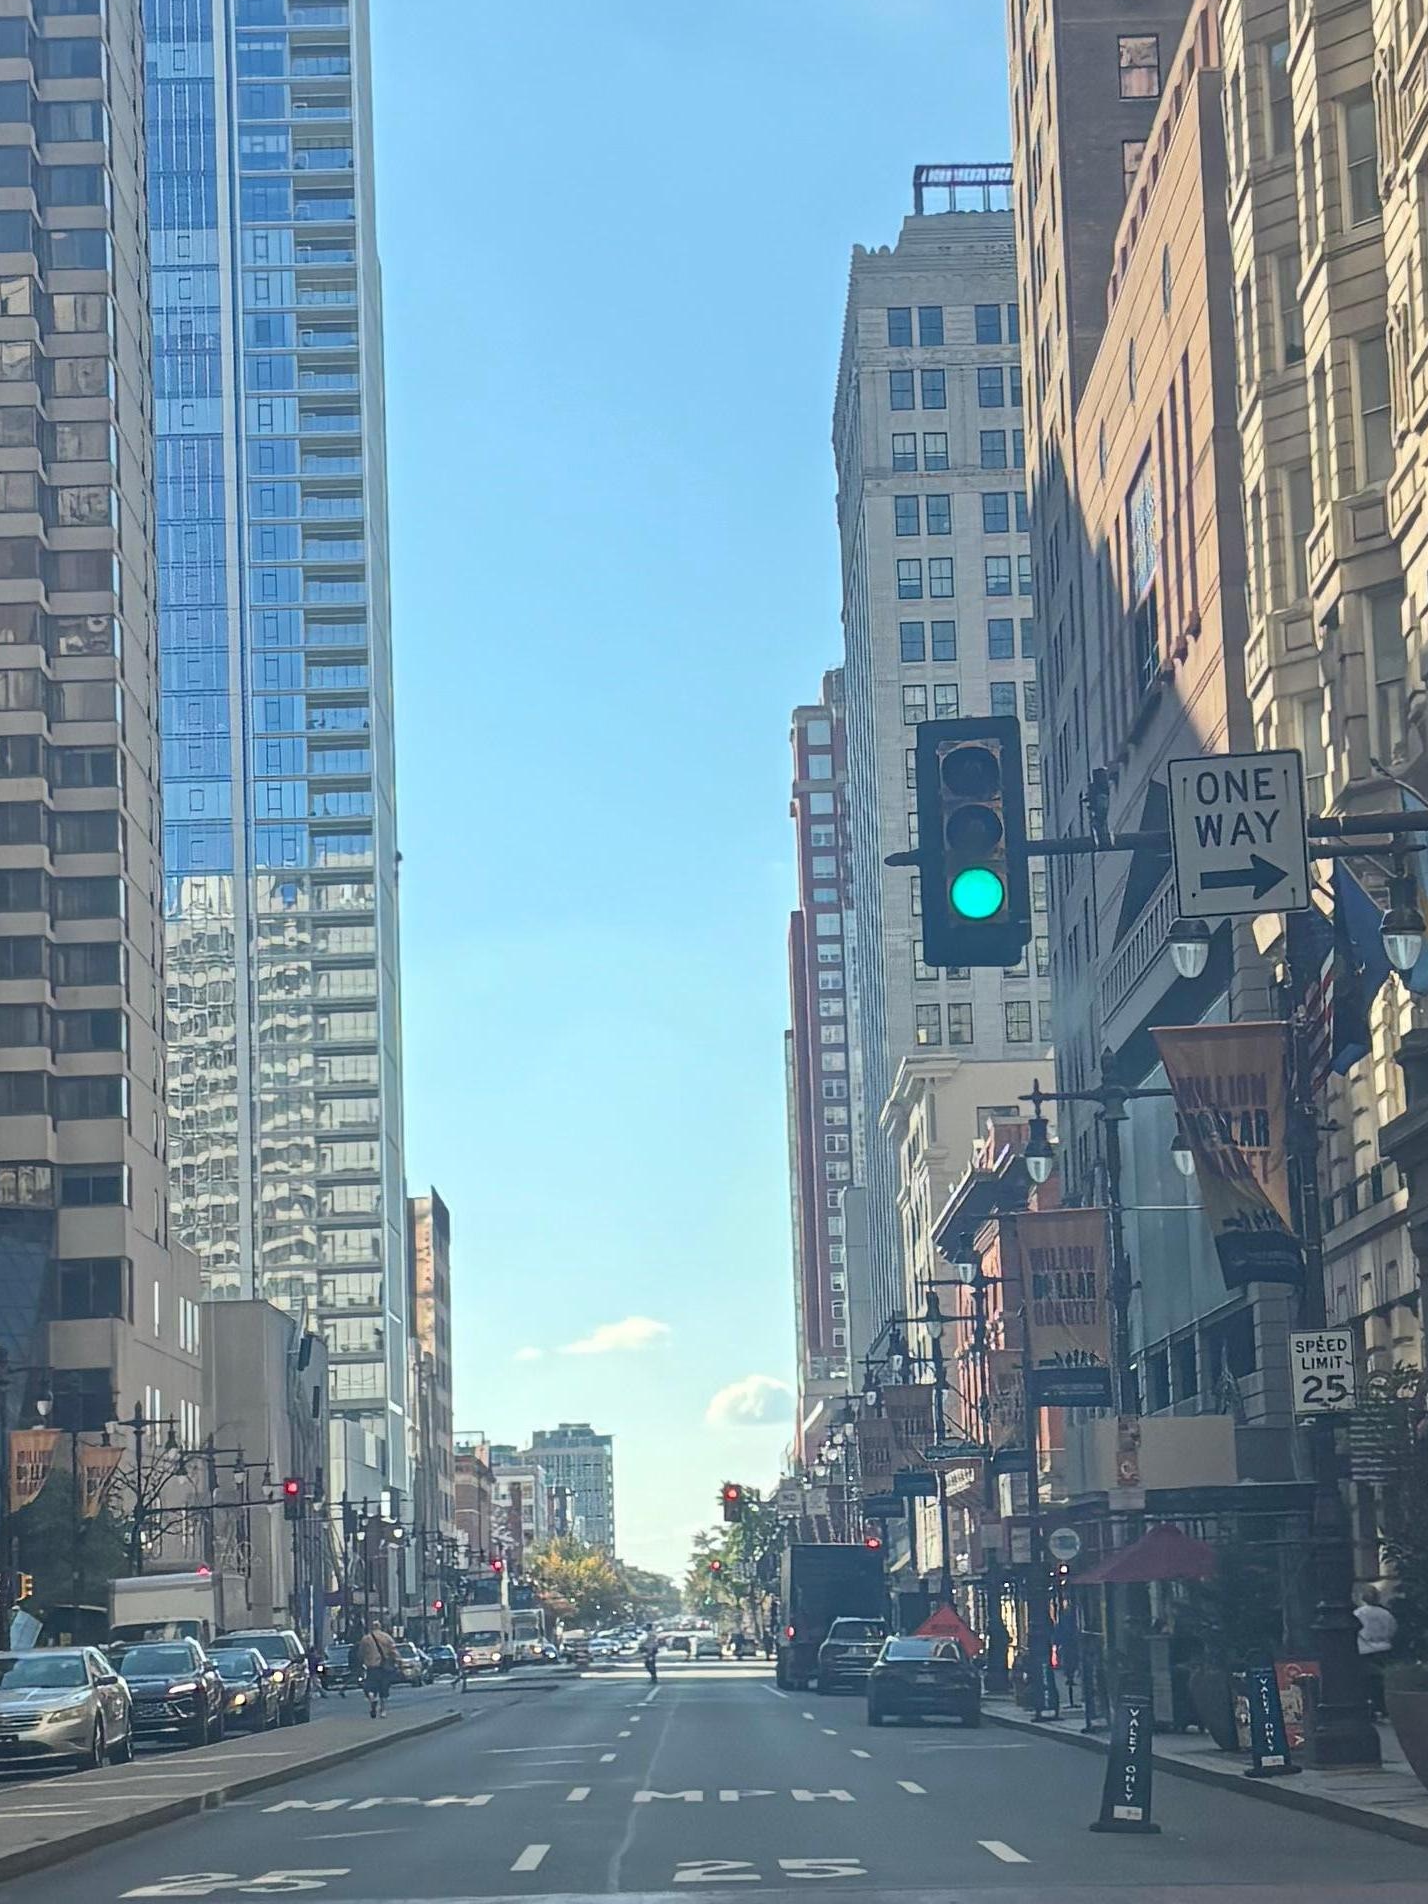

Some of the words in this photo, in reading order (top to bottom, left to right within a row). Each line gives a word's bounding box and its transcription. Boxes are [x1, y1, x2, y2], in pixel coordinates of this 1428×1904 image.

[1196, 767, 1276, 805] ONE
[1194, 809, 1280, 847] WAY
[1295, 1339, 1347, 1354] SPEED
[1302, 1356, 1343, 1370] LIMIT
[1302, 1375, 1348, 1403] 25
[1128, 1708, 1140, 1754] VALET
[632, 1789, 856, 1802] MPH
[1124, 1765, 1136, 1801] ONLY
[117, 1867, 352, 1898] 25
[672, 1858, 869, 1882] 25
